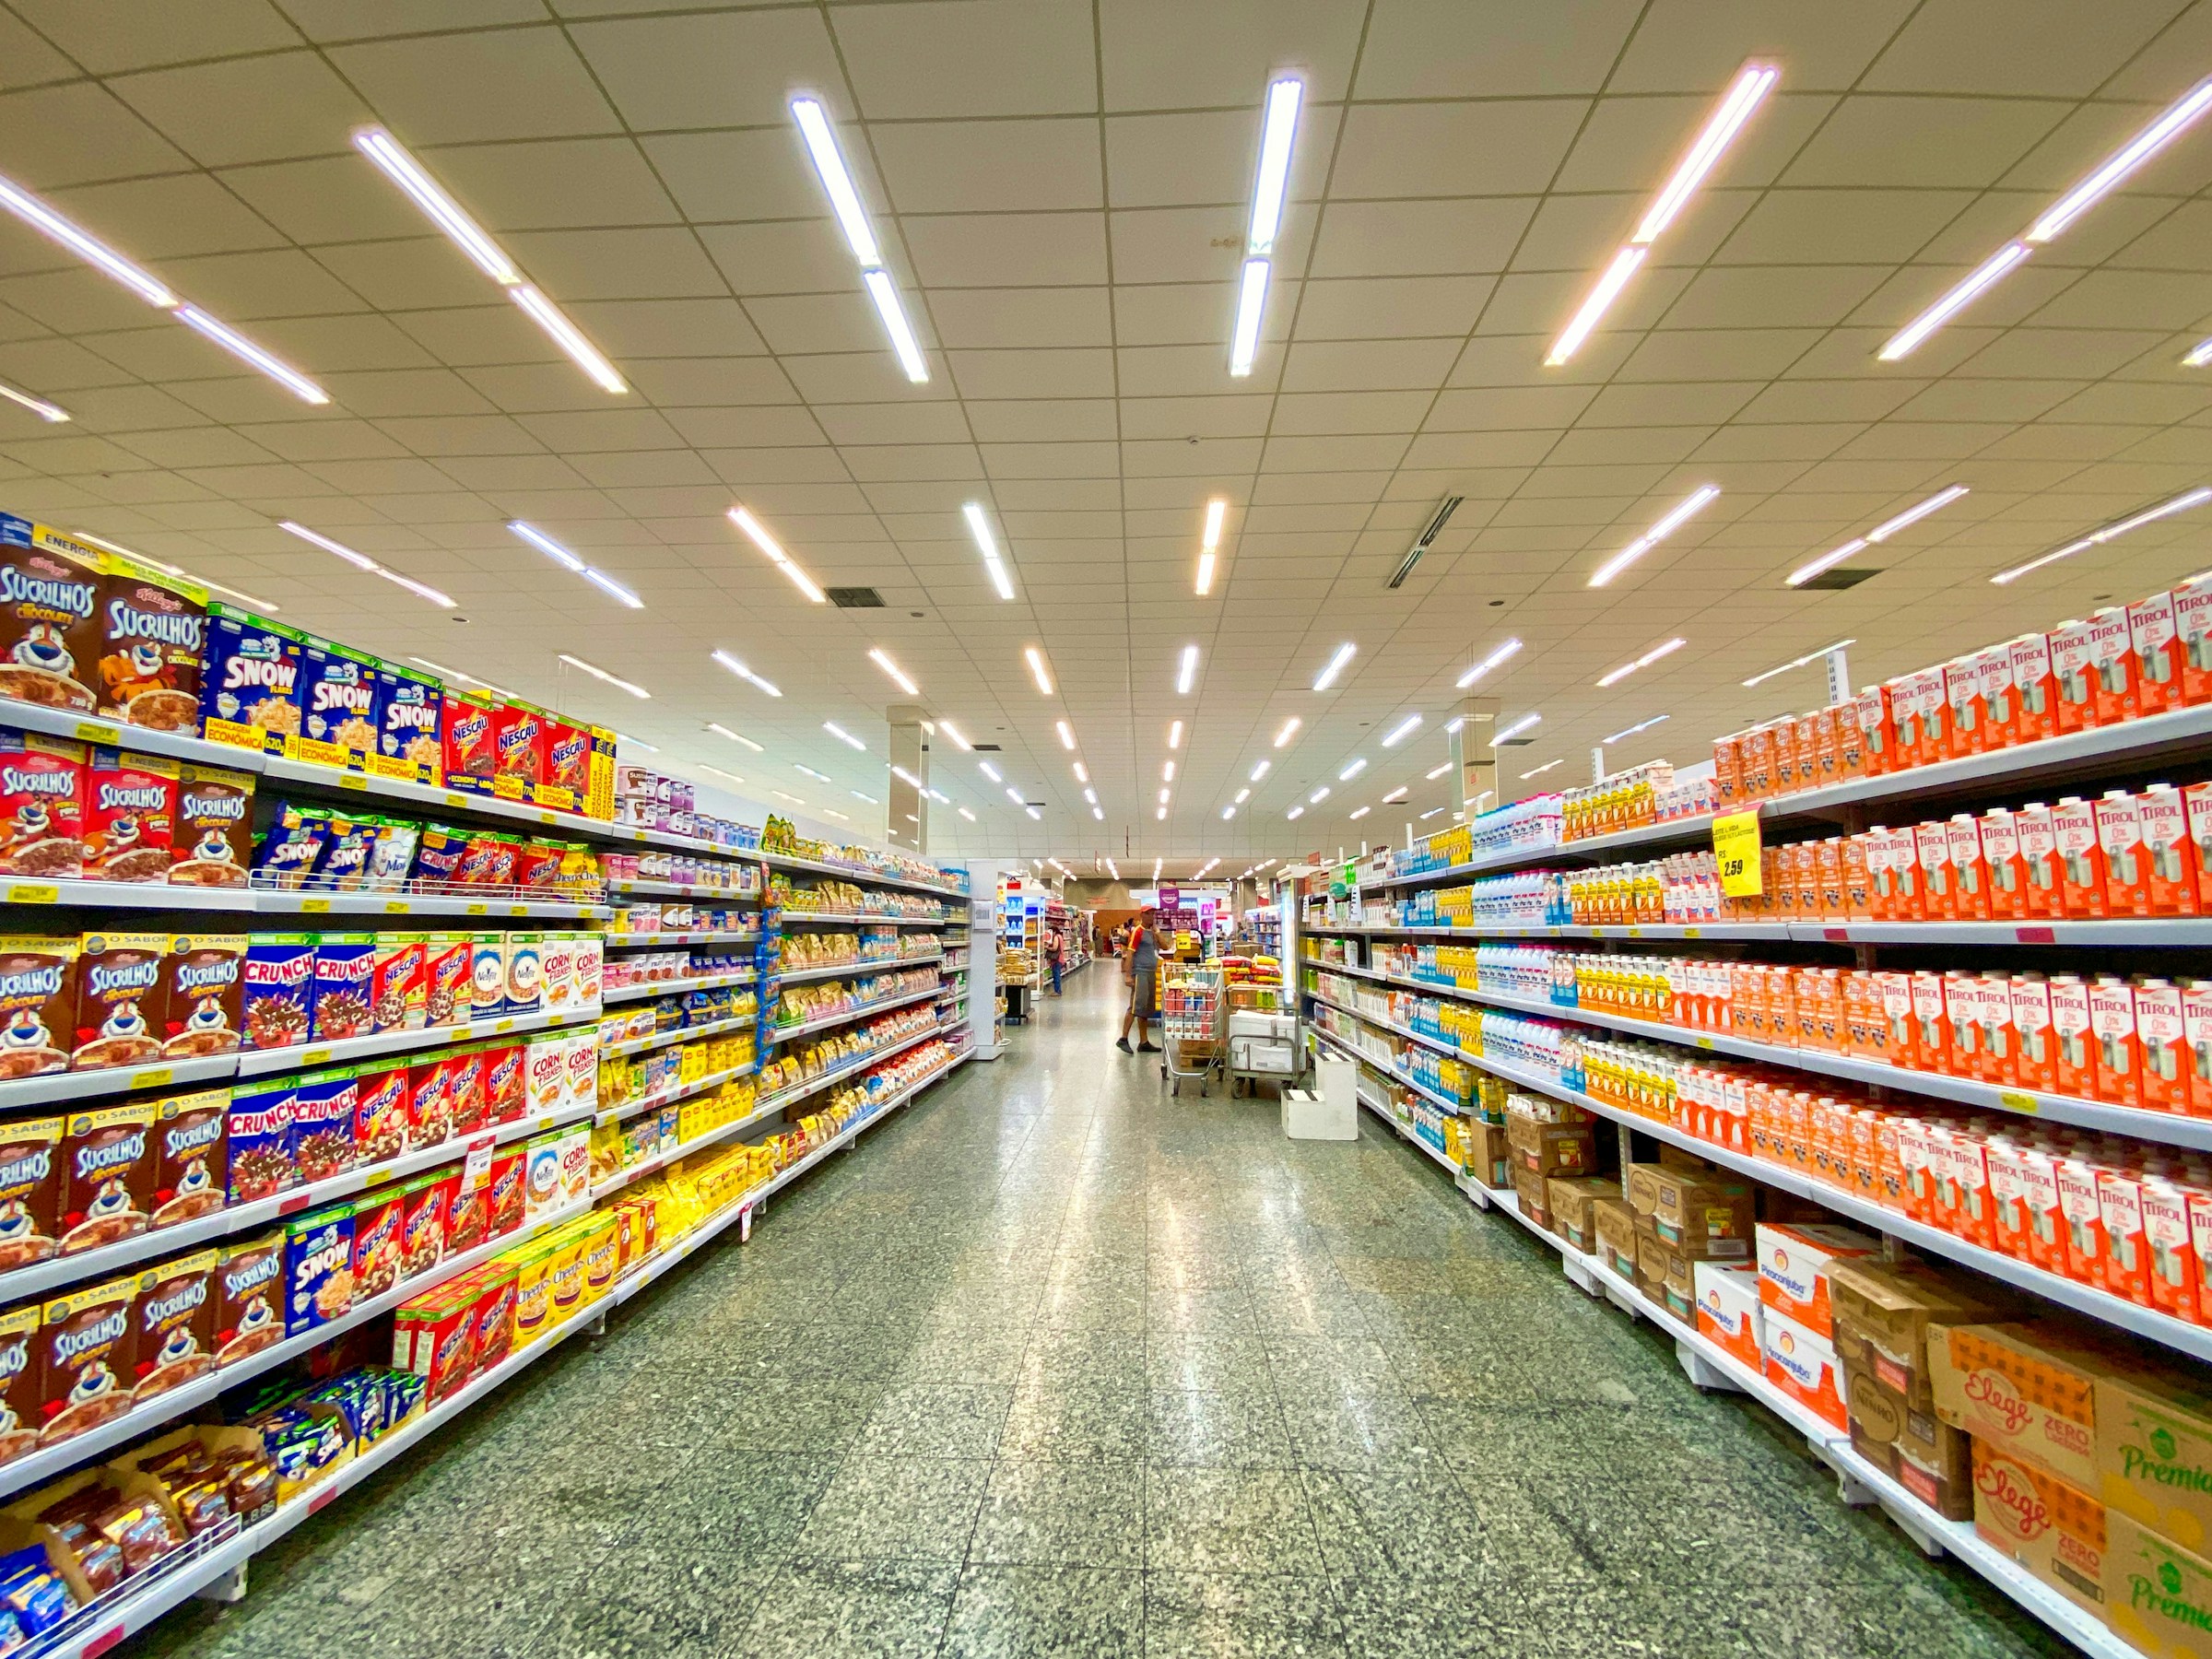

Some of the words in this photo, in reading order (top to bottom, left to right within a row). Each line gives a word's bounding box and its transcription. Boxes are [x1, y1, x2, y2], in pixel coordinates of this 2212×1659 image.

[45, 534, 99, 560] ENERGIA
[1, 565, 95, 618] SUCRILHOS
[109, 600, 204, 653] SUCRILHOS
[2131, 608, 2172, 629] TIROL
[2088, 622, 2127, 643] TIROL
[2052, 636, 2088, 654] TIROL
[1979, 660, 2010, 677] TIROL
[2013, 649, 2046, 666] TIROL
[223, 655, 297, 688] SNOW
[1947, 670, 1978, 687] TIROL
[312, 681, 373, 712] SNOW
[1892, 689, 1915, 703] TIROL
[1917, 681, 1943, 696] TIROL
[387, 702, 437, 730] SNOW
[1858, 700, 1881, 713] TIROL
[209, 719, 251, 735] EMBALAGEM
[453, 715, 488, 743] NESCAU
[499, 721, 538, 752] NESCAU
[207, 728, 263, 750] ECONÔMICA
[301, 738, 336, 752] EMBALAGEM
[300, 747, 347, 767] ECONÔMICA
[551, 737, 585, 766] NESCAU
[3, 766, 75, 797] SUCRILHOS
[376, 763, 417, 780] ECONÔMICA
[99, 783, 166, 811] SUCRILHOS
[183, 793, 246, 820] SUCRILHOS
[2054, 817, 2092, 831] TIROL
[2099, 811, 2138, 827] TIROL
[2141, 805, 2181, 821] TIROL
[1948, 831, 1977, 843] TIROL
[1983, 827, 2015, 841] TIROL
[2018, 821, 2052, 834] TIROL
[1866, 841, 1888, 853] TIROL
[1888, 839, 1913, 851] TIROL
[1918, 835, 1946, 847] TIROL
[269, 840, 323, 865] SNOW
[461, 850, 492, 875] NESCAU
[528, 856, 560, 881] NESCAU
[124, 935, 169, 944] SABOR
[207, 936, 248, 945] SABOR
[245, 953, 313, 982] CRUNCH
[316, 953, 376, 979] CRUNCH
[384, 952, 422, 983] NESCAU
[436, 950, 468, 980] NESCAU
[545, 952, 571, 973] CORN
[576, 951, 599, 971] CORN
[90, 959, 159, 996] SUCRILHOS
[177, 959, 240, 994] SUCRILHOS
[1884, 984, 1909, 998] TIROL
[1913, 986, 1940, 1000] TIROL
[1947, 989, 1975, 1003] TIROL
[1976, 991, 2009, 1005] TIROL
[2012, 993, 2047, 1007] TIROL
[2052, 995, 2088, 1011] TIROL
[2092, 998, 2132, 1014] TIROL
[2136, 1001, 2181, 1018] TIROL
[534, 1053, 560, 1077] CORN
[569, 1045, 593, 1069] CORN
[452, 1060, 480, 1095] NESCAU
[489, 1052, 521, 1089] NESCAU
[194, 1091, 230, 1104] SABOR
[359, 1077, 405, 1125] NESCAU
[414, 1069, 451, 1112] NESCAU
[111, 1105, 157, 1119] SABOR
[296, 1087, 359, 1121] CRUNCH
[230, 1097, 298, 1135] CRUNCH
[11, 1121, 62, 1135] SABOR
[167, 1114, 223, 1159] SUCRILHOS
[1900, 1134, 1926, 1151] TIROL
[76, 1131, 147, 1180] SUCRILHOS
[563, 1145, 586, 1170] CORN
[1953, 1151, 1983, 1170] TIROL
[492, 1159, 524, 1201] NESCAU
[1989, 1160, 2021, 1180] TIROL
[2059, 1179, 2096, 1200] TIROL
[2100, 1189, 2138, 1212] TIROL
[405, 1192, 441, 1240] NESCAU
[2143, 1201, 2184, 1224] TIROL
[357, 1208, 400, 1262] NESCAU
[173, 1252, 216, 1271] SABOR
[295, 1239, 350, 1290] SNOW
[554, 1260, 584, 1284] Cheerios
[226, 1253, 279, 1300] SUCRILHOS
[1761, 1264, 1806, 1294] Piracanjuba
[88, 1279, 136, 1300] SABOR
[517, 1278, 551, 1305] Cheerios
[145, 1277, 207, 1331] SUCRILHOS
[55, 1306, 128, 1367] SUCRILHOS
